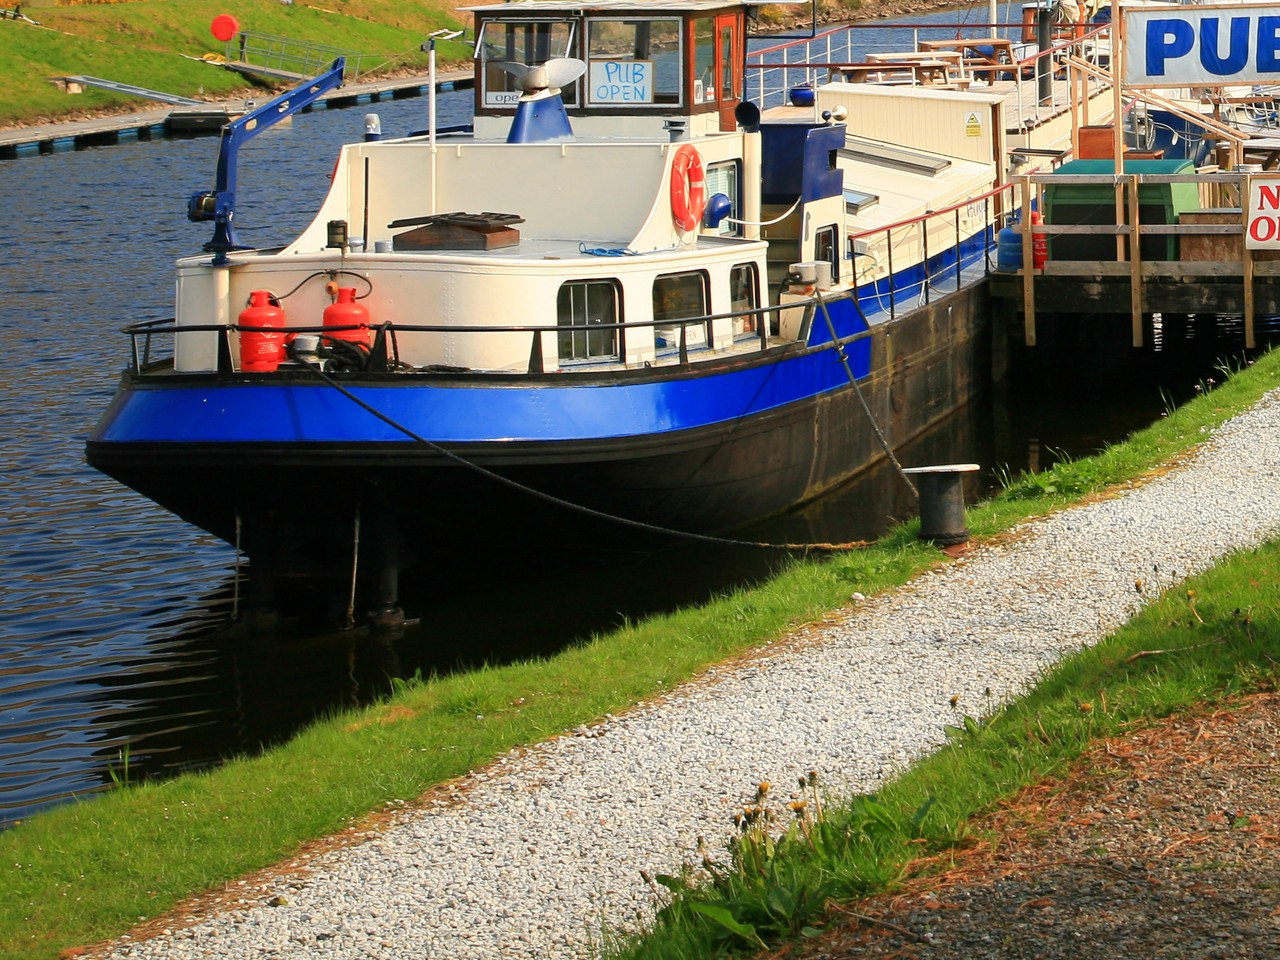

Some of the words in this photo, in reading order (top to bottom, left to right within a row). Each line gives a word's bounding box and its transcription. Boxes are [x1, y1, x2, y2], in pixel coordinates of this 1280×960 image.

[605, 62, 645, 84] PUB
[495, 94, 519, 104] ope
[596, 85, 645, 101] OPEN
